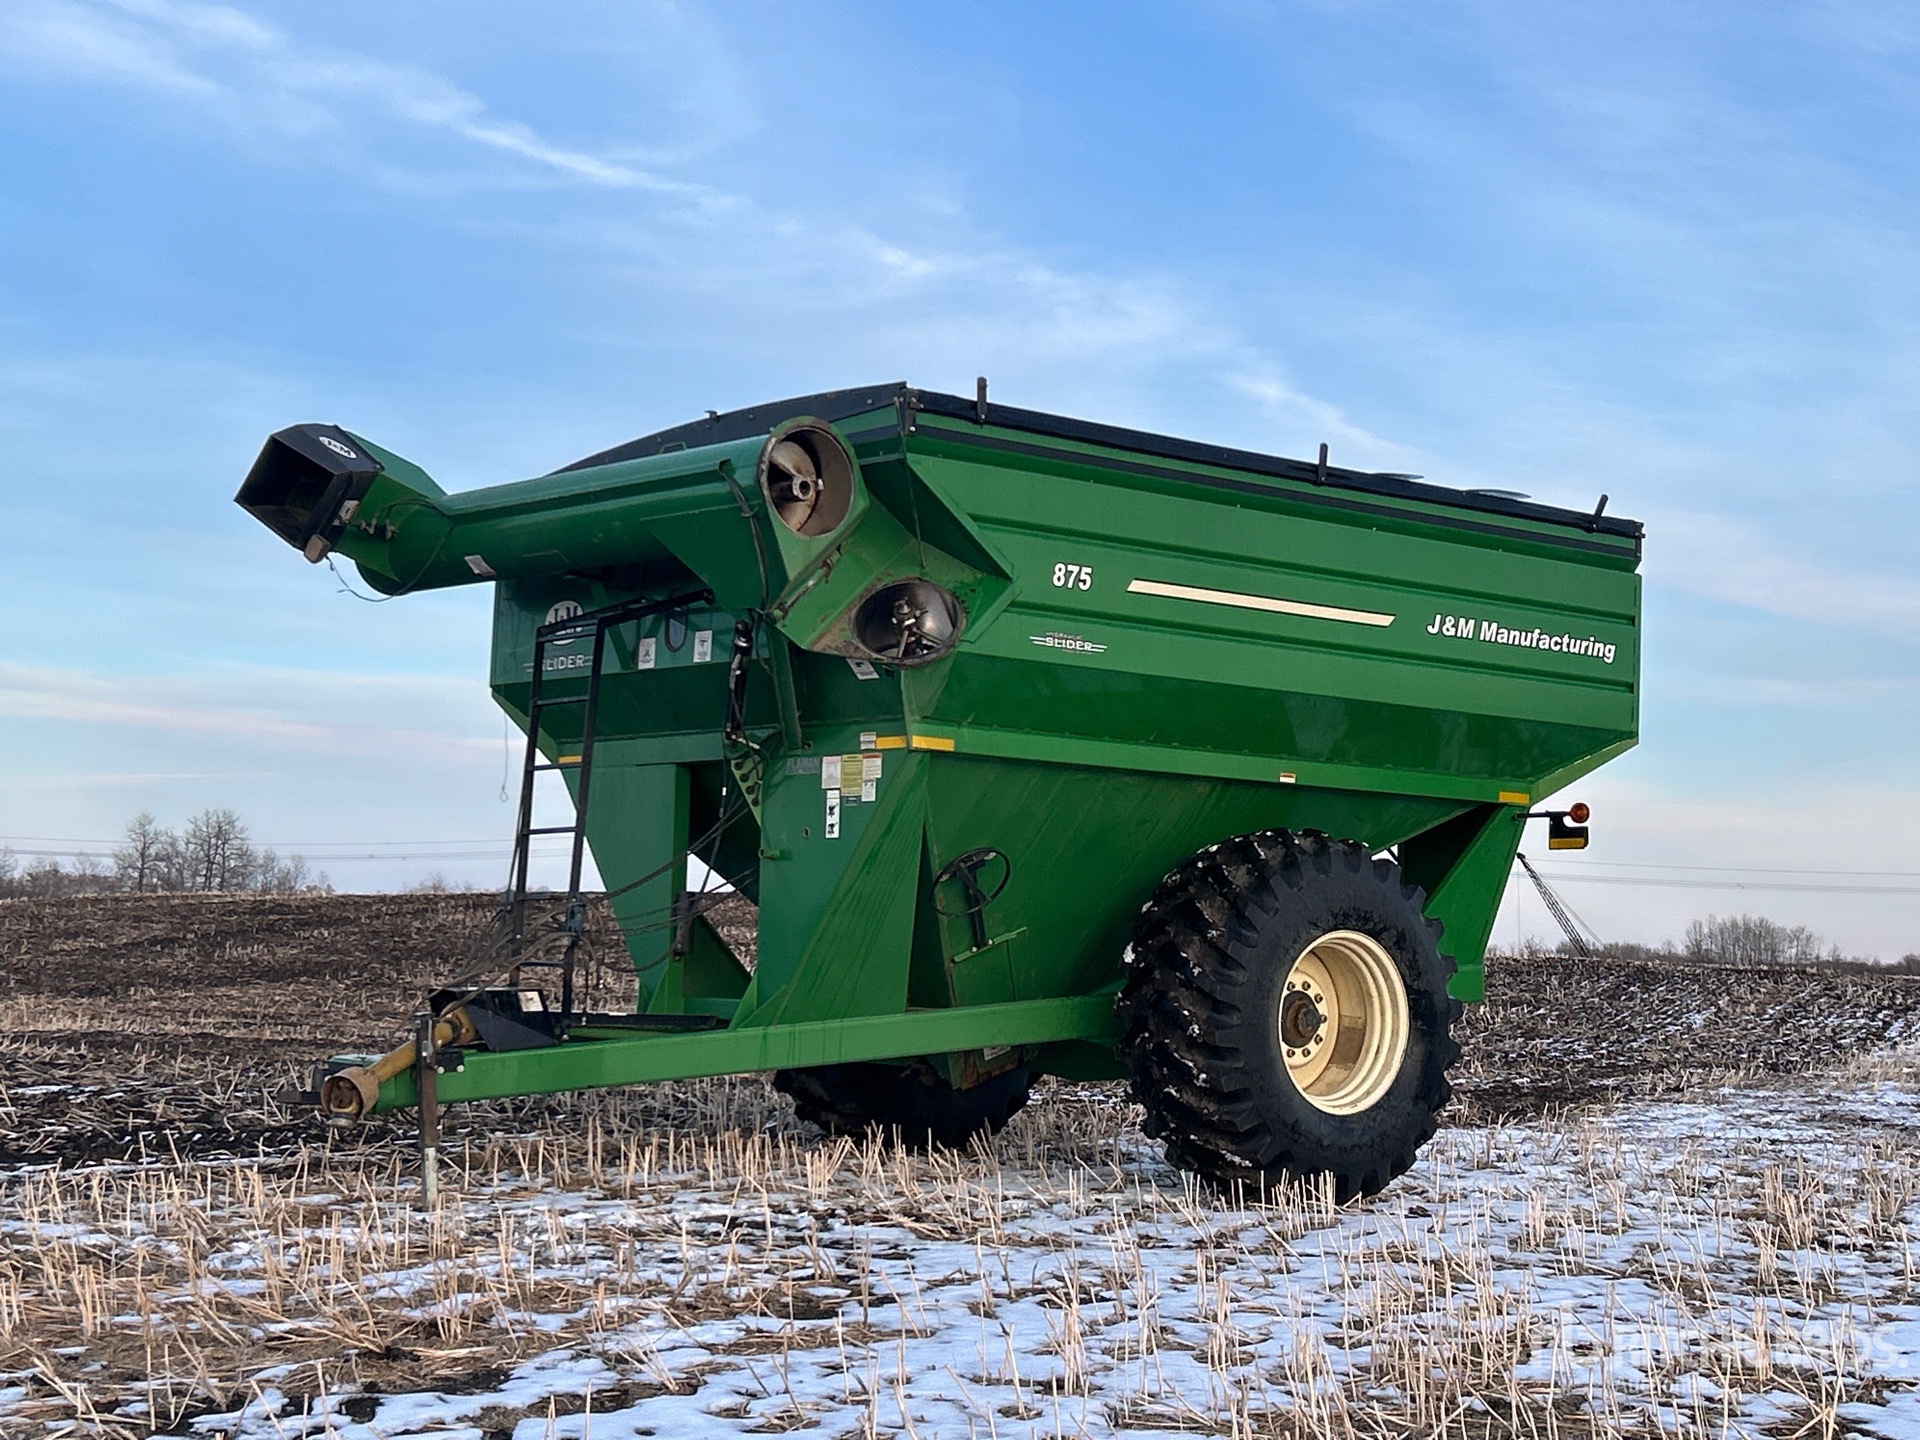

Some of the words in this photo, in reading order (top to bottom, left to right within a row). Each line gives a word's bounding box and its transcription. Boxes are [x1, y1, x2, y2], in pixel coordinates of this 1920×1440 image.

[1052, 562, 1093, 591] 875
[1045, 636, 1093, 651] SLIDER
[1426, 613, 1475, 640] J&M
[1478, 619, 1617, 664] Manufacturing
